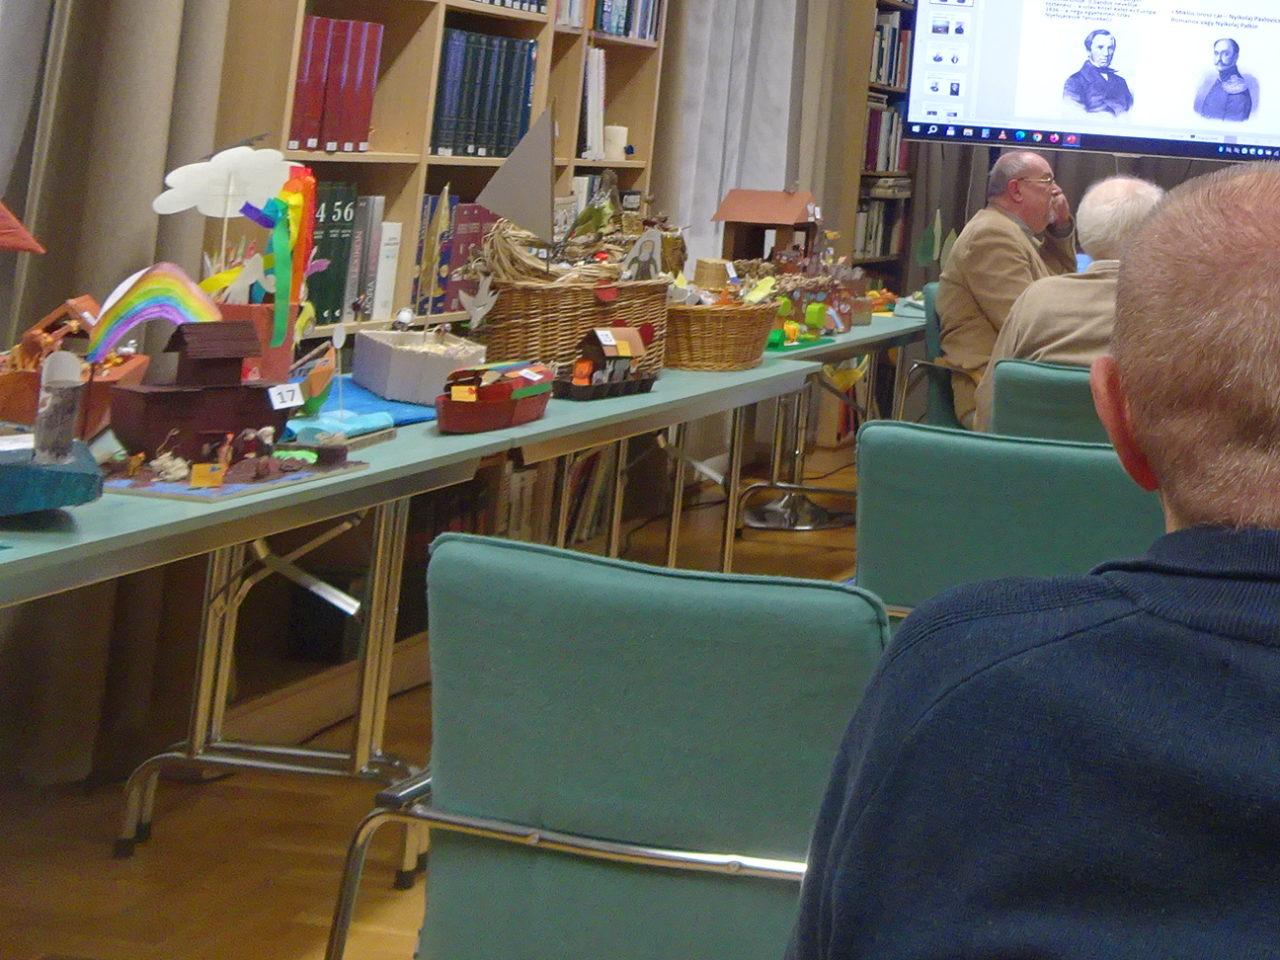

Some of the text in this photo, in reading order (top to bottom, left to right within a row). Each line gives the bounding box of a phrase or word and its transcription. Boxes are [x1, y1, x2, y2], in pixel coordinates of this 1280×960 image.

[315, 202, 326, 222] 4
[332, 201, 343, 222] 5
[343, 200, 355, 222] 6
[276, 389, 296, 404] 17
